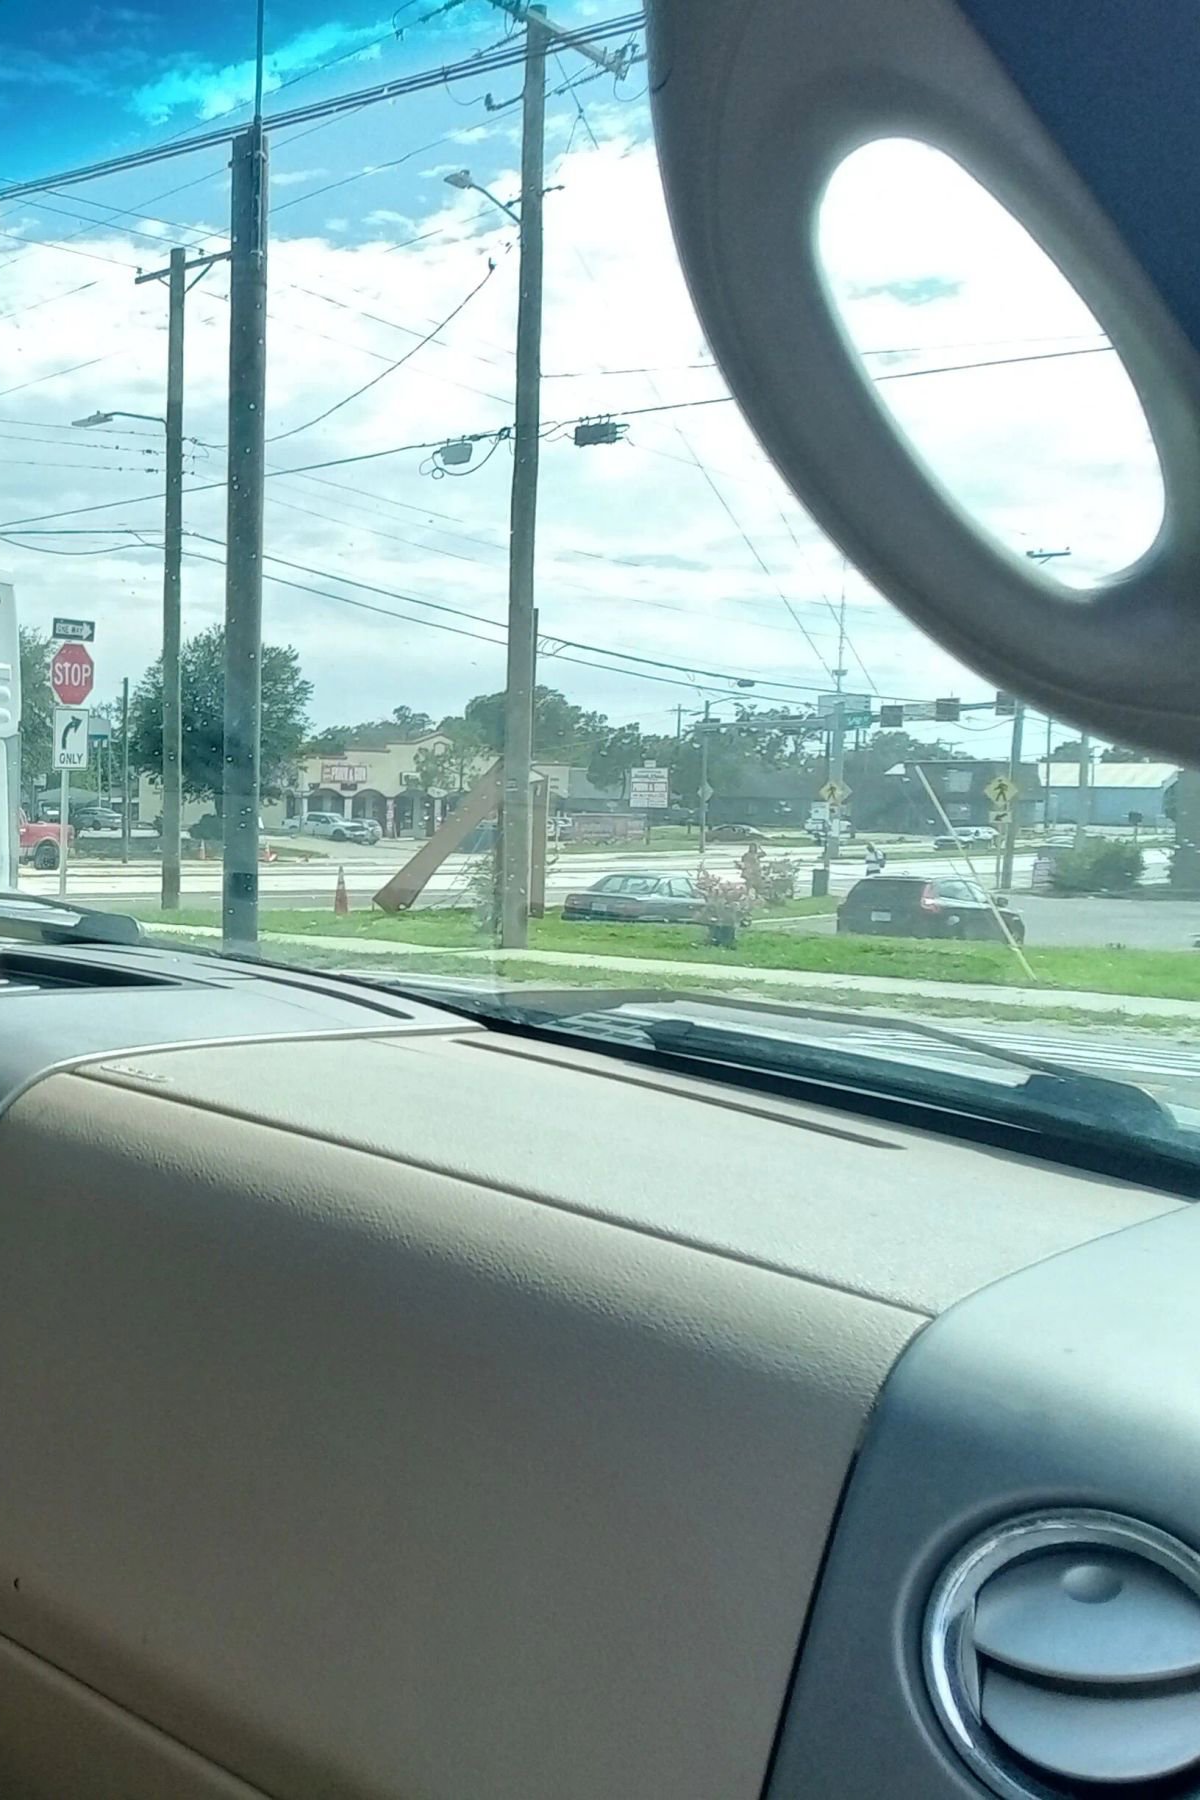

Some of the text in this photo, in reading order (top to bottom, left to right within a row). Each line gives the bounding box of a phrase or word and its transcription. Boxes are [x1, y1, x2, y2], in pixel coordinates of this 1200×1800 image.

[57, 624, 83, 634] ONE WAY
[54, 662, 91, 686] STOP
[59, 753, 84, 764] ONLY
